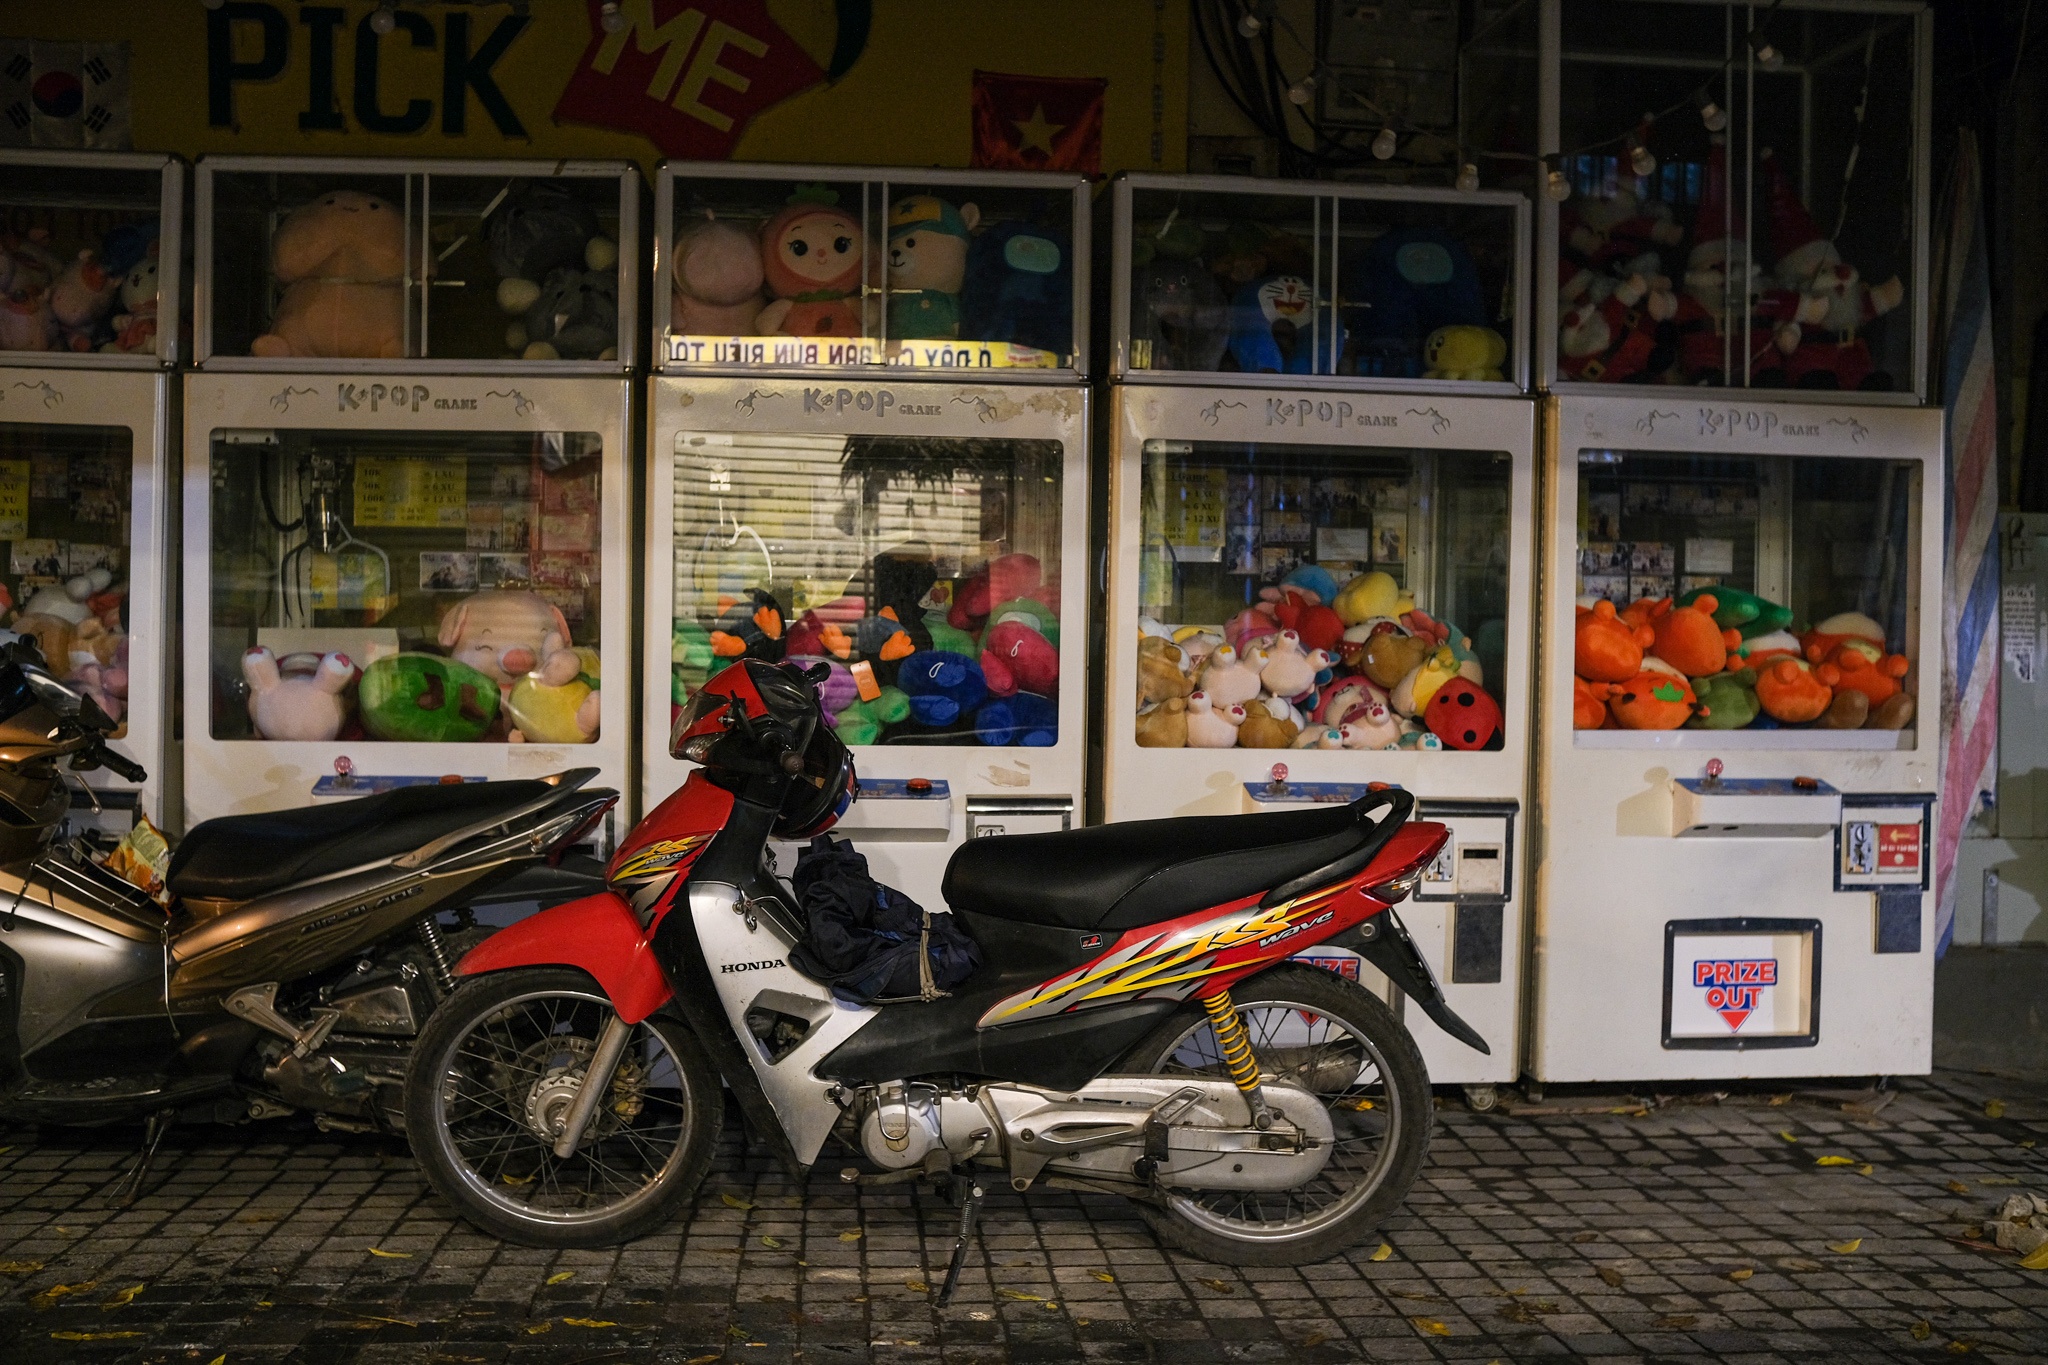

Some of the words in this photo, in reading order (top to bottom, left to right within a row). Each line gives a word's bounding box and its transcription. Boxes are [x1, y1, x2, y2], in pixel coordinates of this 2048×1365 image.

[207, 3, 532, 138] PICK
[590, 0, 770, 133] ME
[720, 959, 787, 974] HONDA
[1696, 961, 1776, 985] PRIZE
[1705, 986, 1764, 1010] OUT
